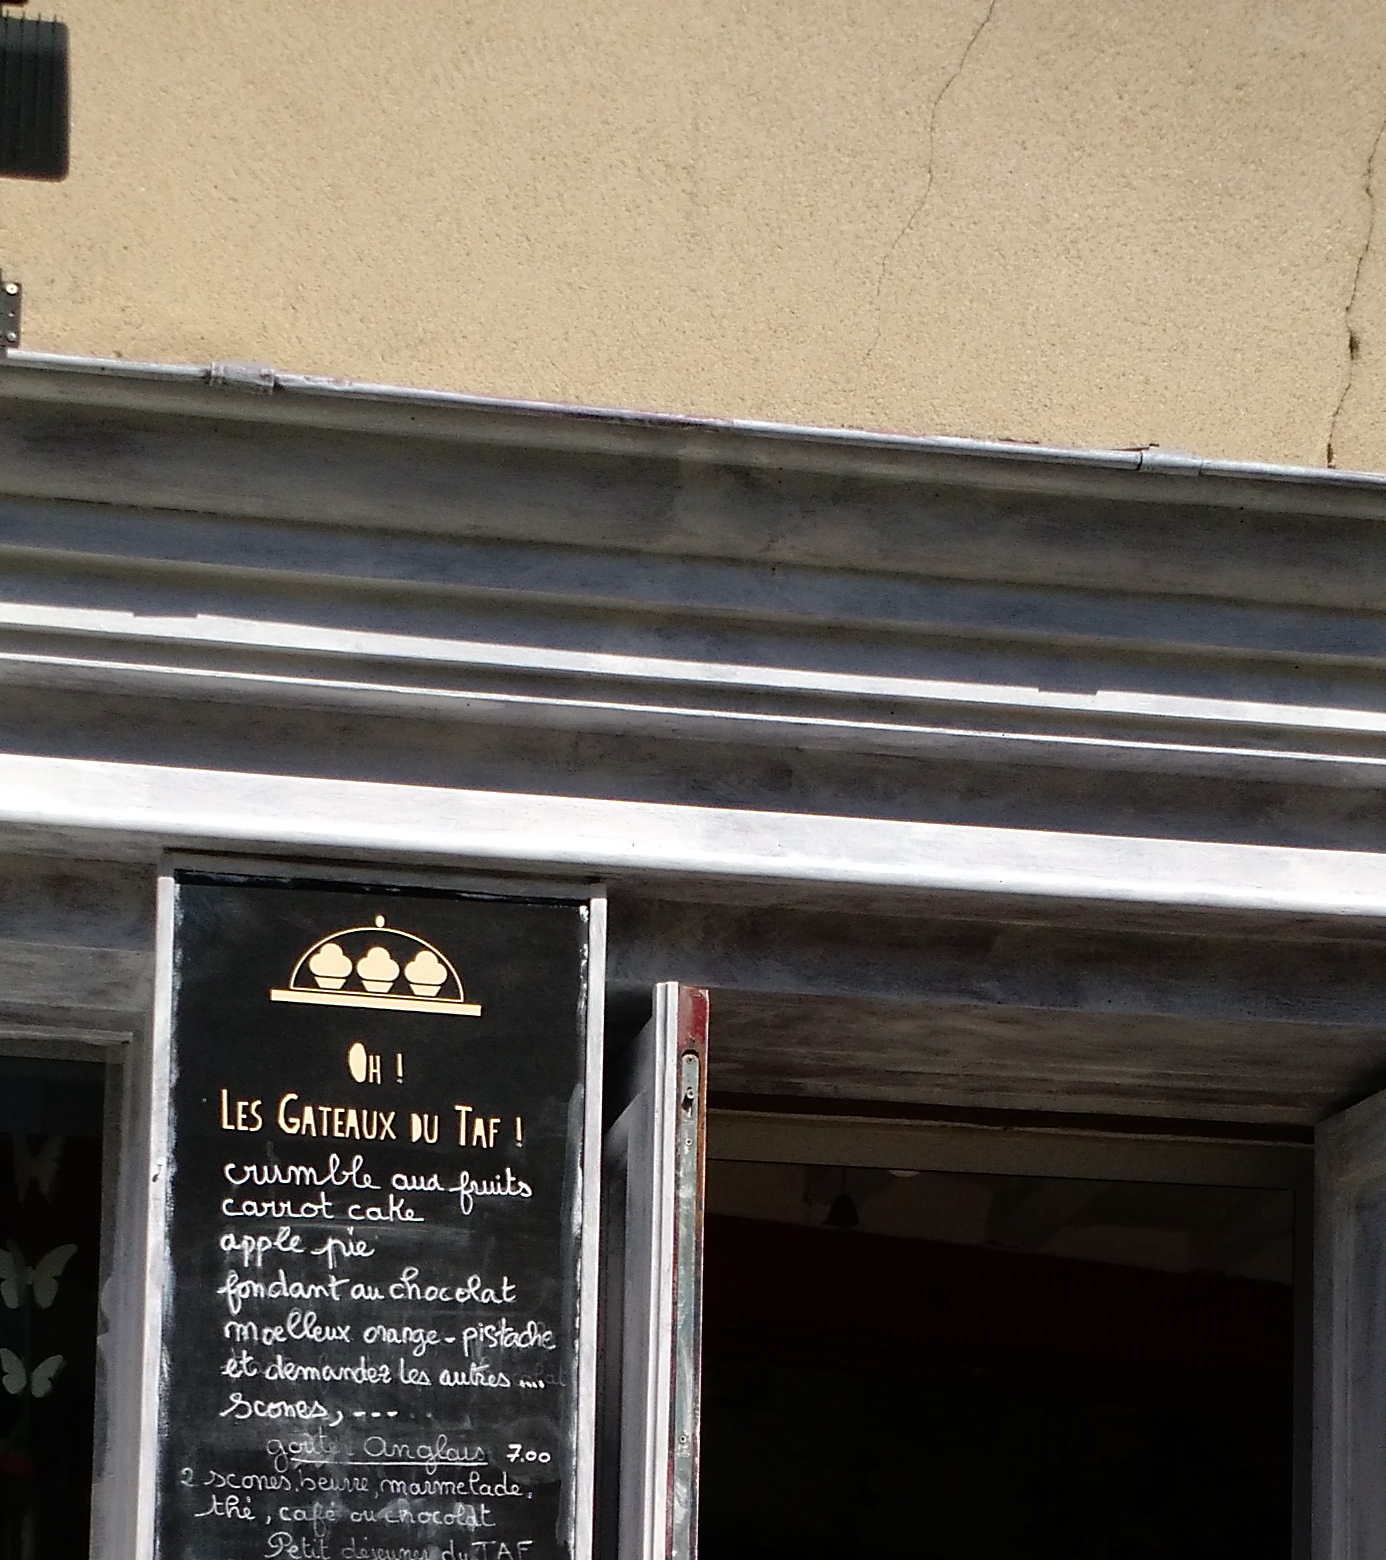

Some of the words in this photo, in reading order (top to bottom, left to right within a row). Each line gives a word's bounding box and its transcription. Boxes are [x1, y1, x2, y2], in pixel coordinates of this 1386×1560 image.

[220, 1089, 262, 1131] LES
[278, 1093, 396, 1140] GATEAUX
[411, 1112, 438, 1143] DU
[455, 1105, 500, 1148] TAF
[224, 1154, 380, 1190] crumble
[449, 1168, 532, 1214] fruits
[222, 1192, 335, 1219] carrot
[348, 1194, 424, 1222] cake
[220, 1226, 305, 1267] apple
[311, 1227, 374, 1269] pie
[217, 1269, 350, 1314] fondant
[350, 1283, 384, 1301] au
[389, 1267, 515, 1303] chocolat
[224, 1312, 350, 1346] moelleux
[221, 1351, 257, 1377] et
[266, 1351, 392, 1385] demandez
[400, 1364, 431, 1386] les
[440, 1362, 510, 1389] autres
[507, 1444, 551, 1463] 7.00
[182, 1470, 193, 1486] 2
[279, 1506, 335, 1539] café
[350, 1511, 377, 1524] ou
[383, 1504, 496, 1527] chocolat
[267, 1532, 330, 1560] Petit
